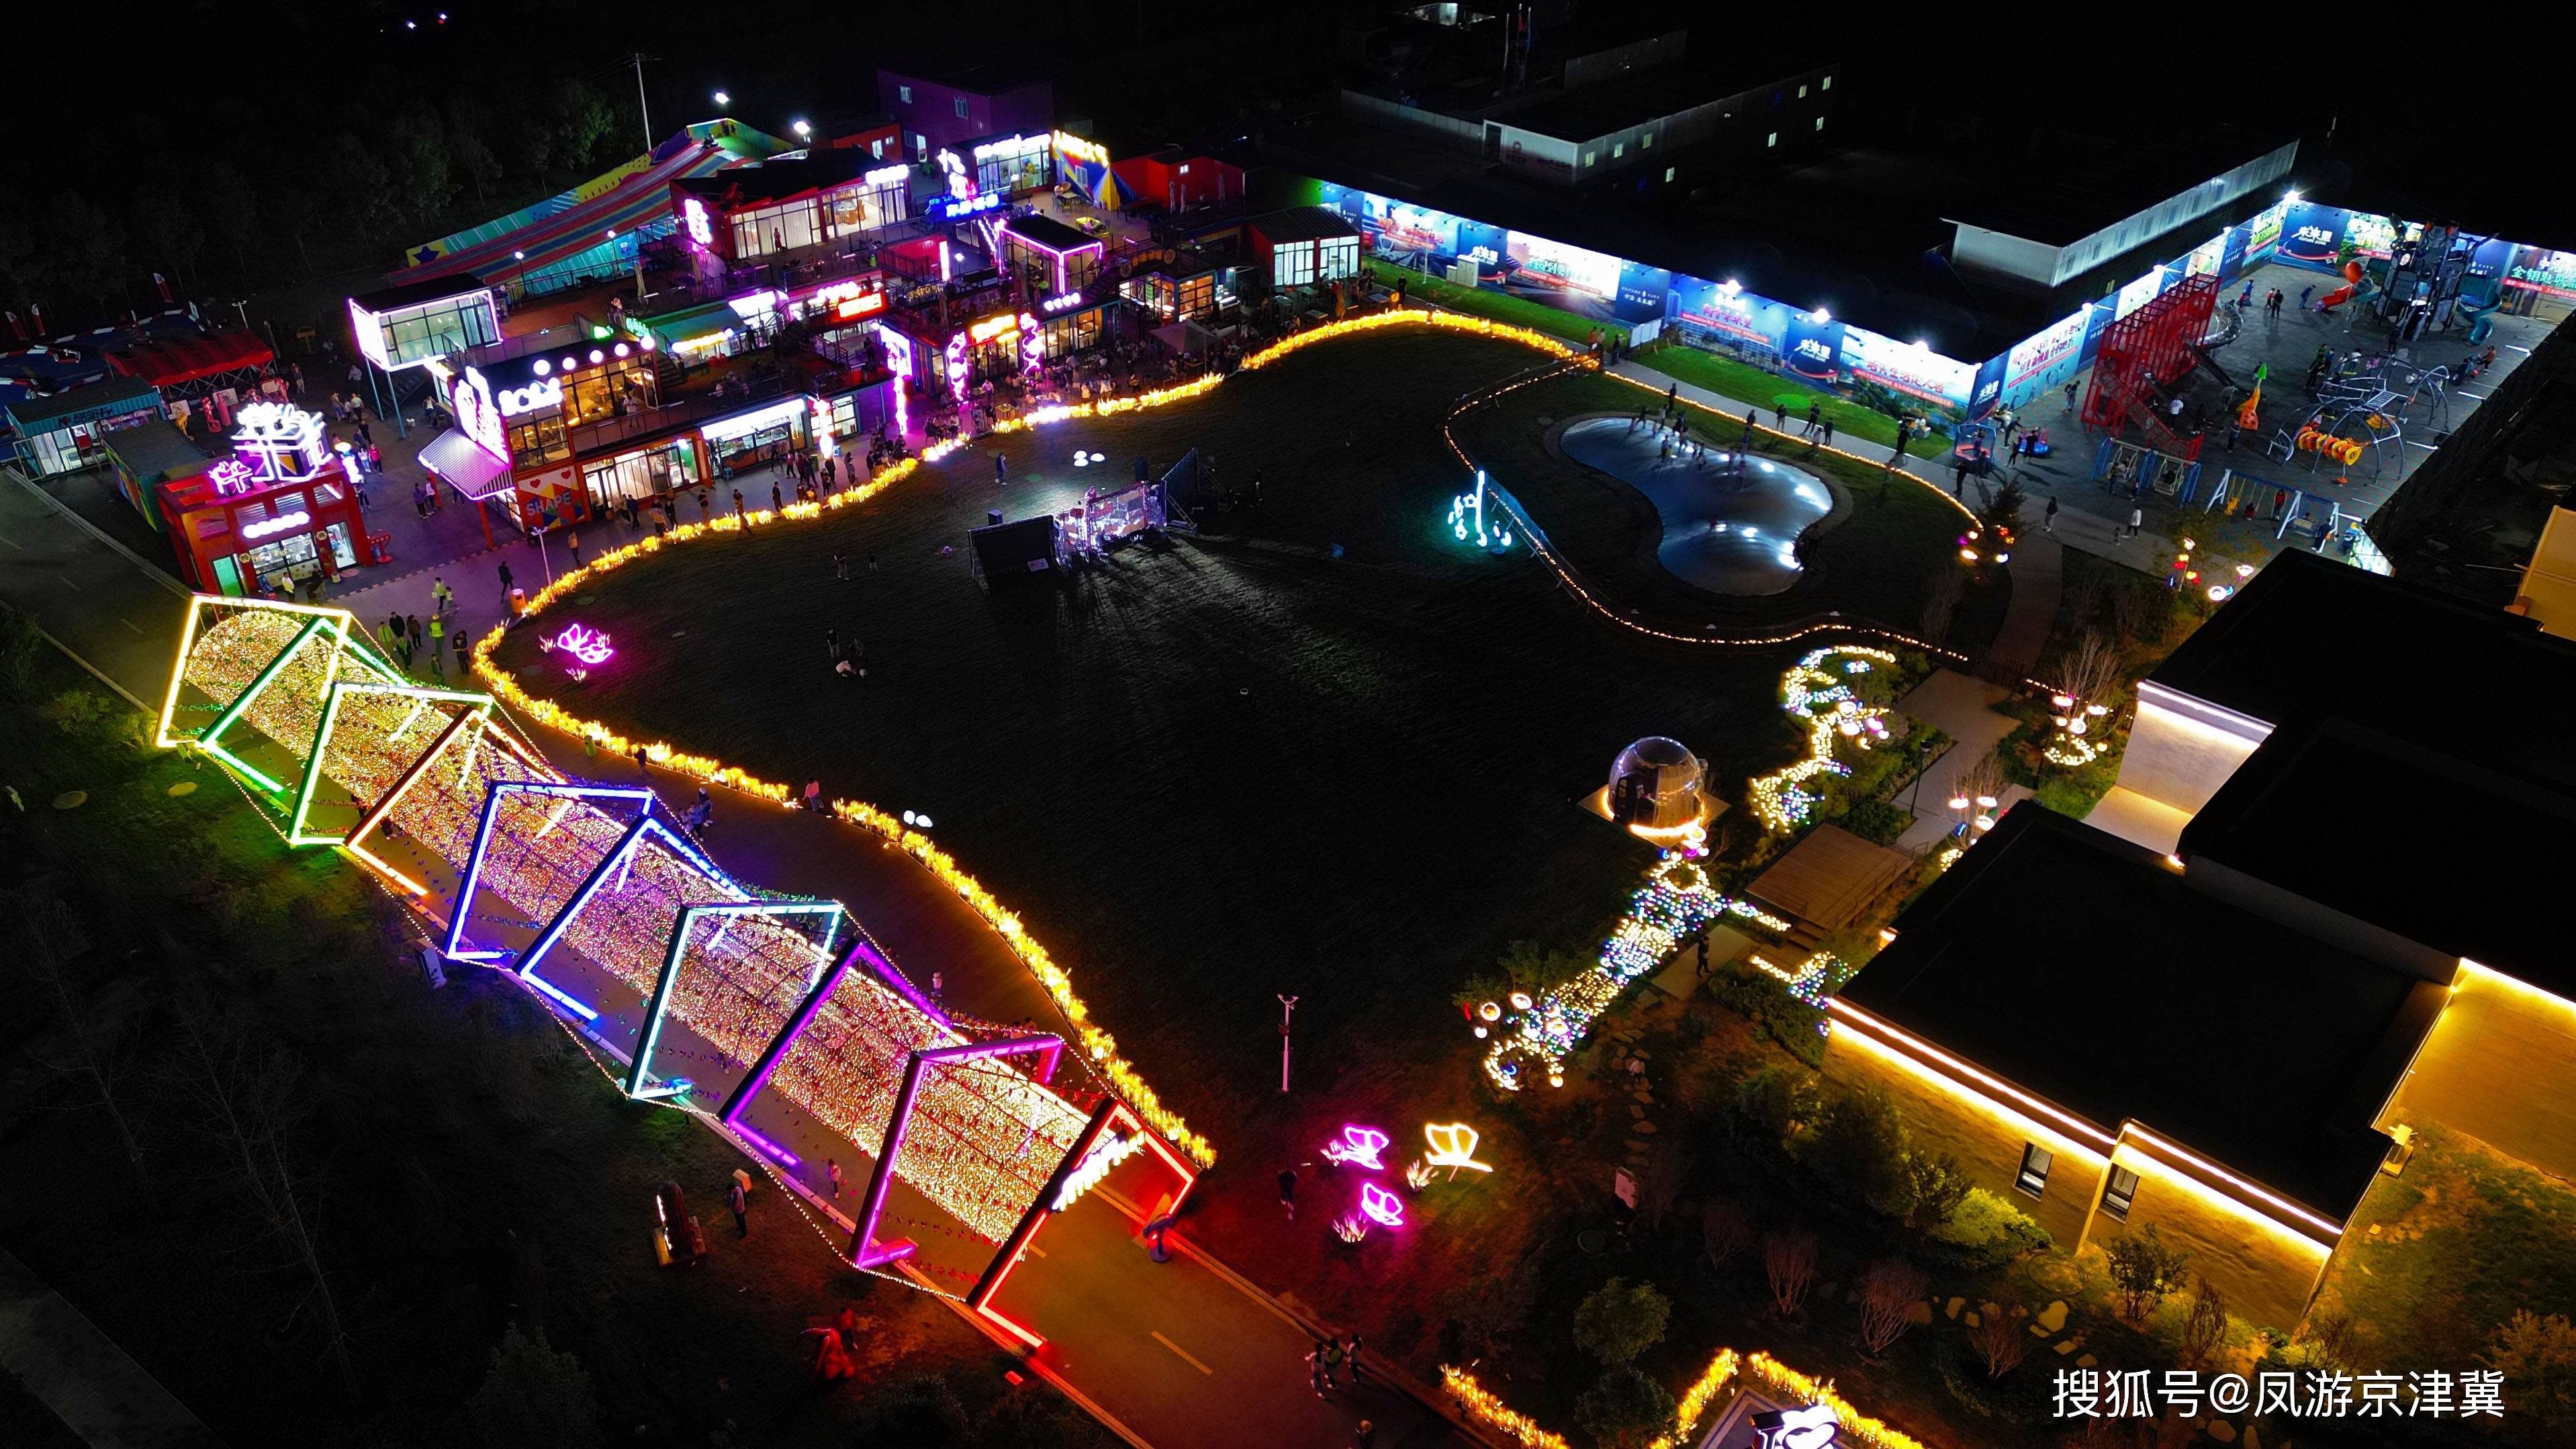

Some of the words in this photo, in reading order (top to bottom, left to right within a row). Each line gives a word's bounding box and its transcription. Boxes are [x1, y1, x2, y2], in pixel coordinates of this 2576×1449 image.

[2291, 226, 2332, 242] 未来里
[1794, 339, 1831, 359] 未来里
[525, 490, 572, 516] SHAPE
